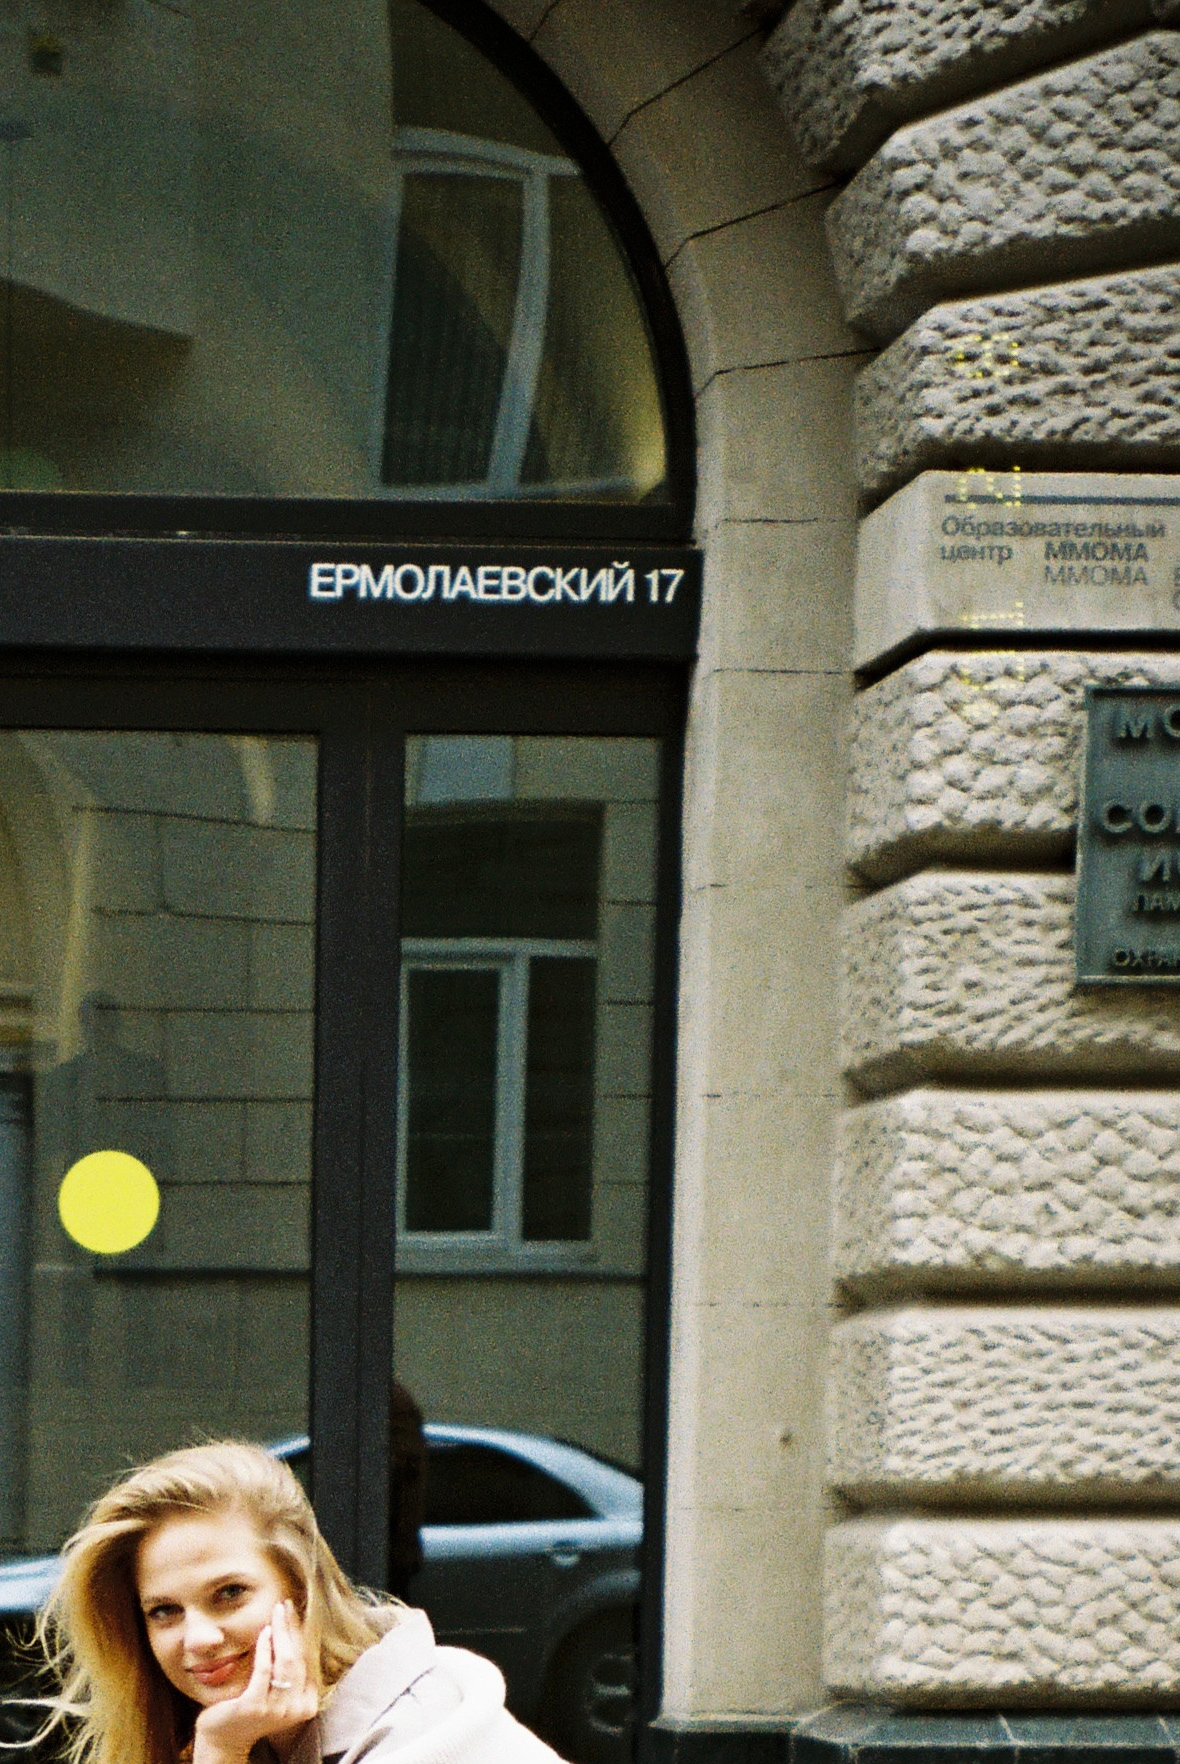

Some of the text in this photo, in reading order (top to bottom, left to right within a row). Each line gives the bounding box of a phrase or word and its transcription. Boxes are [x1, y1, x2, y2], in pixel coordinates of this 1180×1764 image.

[940, 514, 1166, 541] Образовательный
[939, 543, 1014, 566] центр
[310, 560, 686, 604] ЕРМОЛАЕВСКИЙ 17
